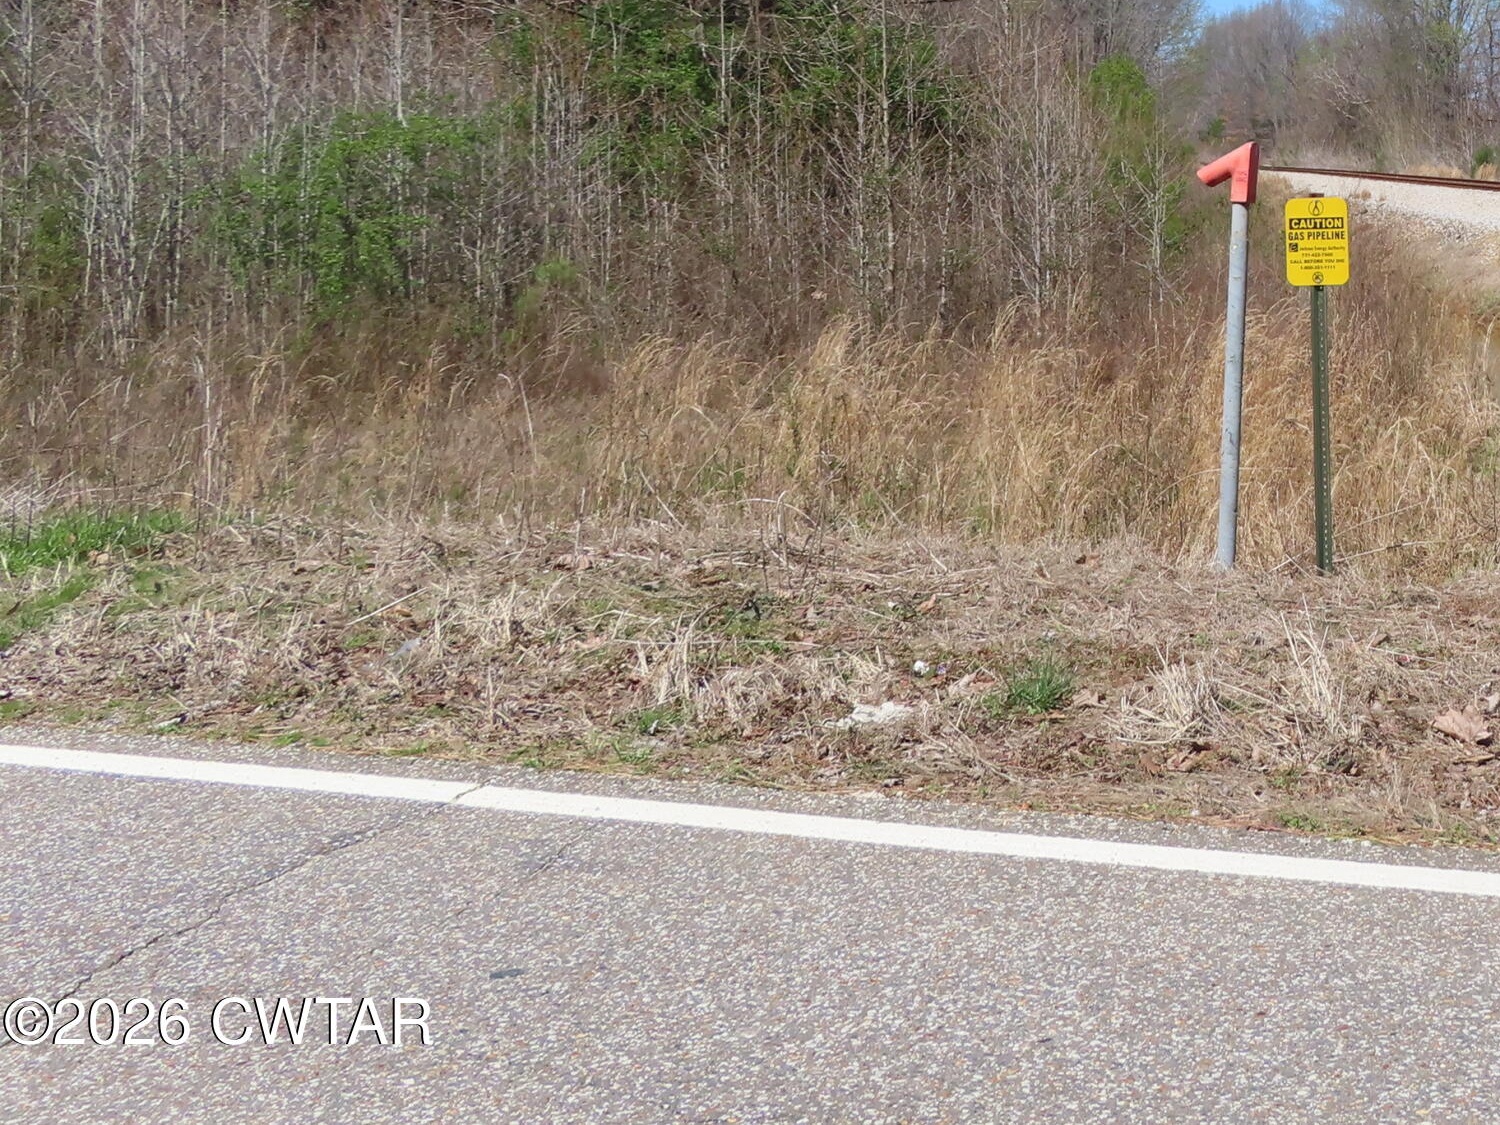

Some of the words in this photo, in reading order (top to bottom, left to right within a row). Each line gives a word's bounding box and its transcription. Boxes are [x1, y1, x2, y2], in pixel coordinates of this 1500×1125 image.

[1291, 218, 1342, 229] CAUTION
[1288, 231, 1304, 241] GAS
[1307, 230, 1345, 240] PIPELINE
